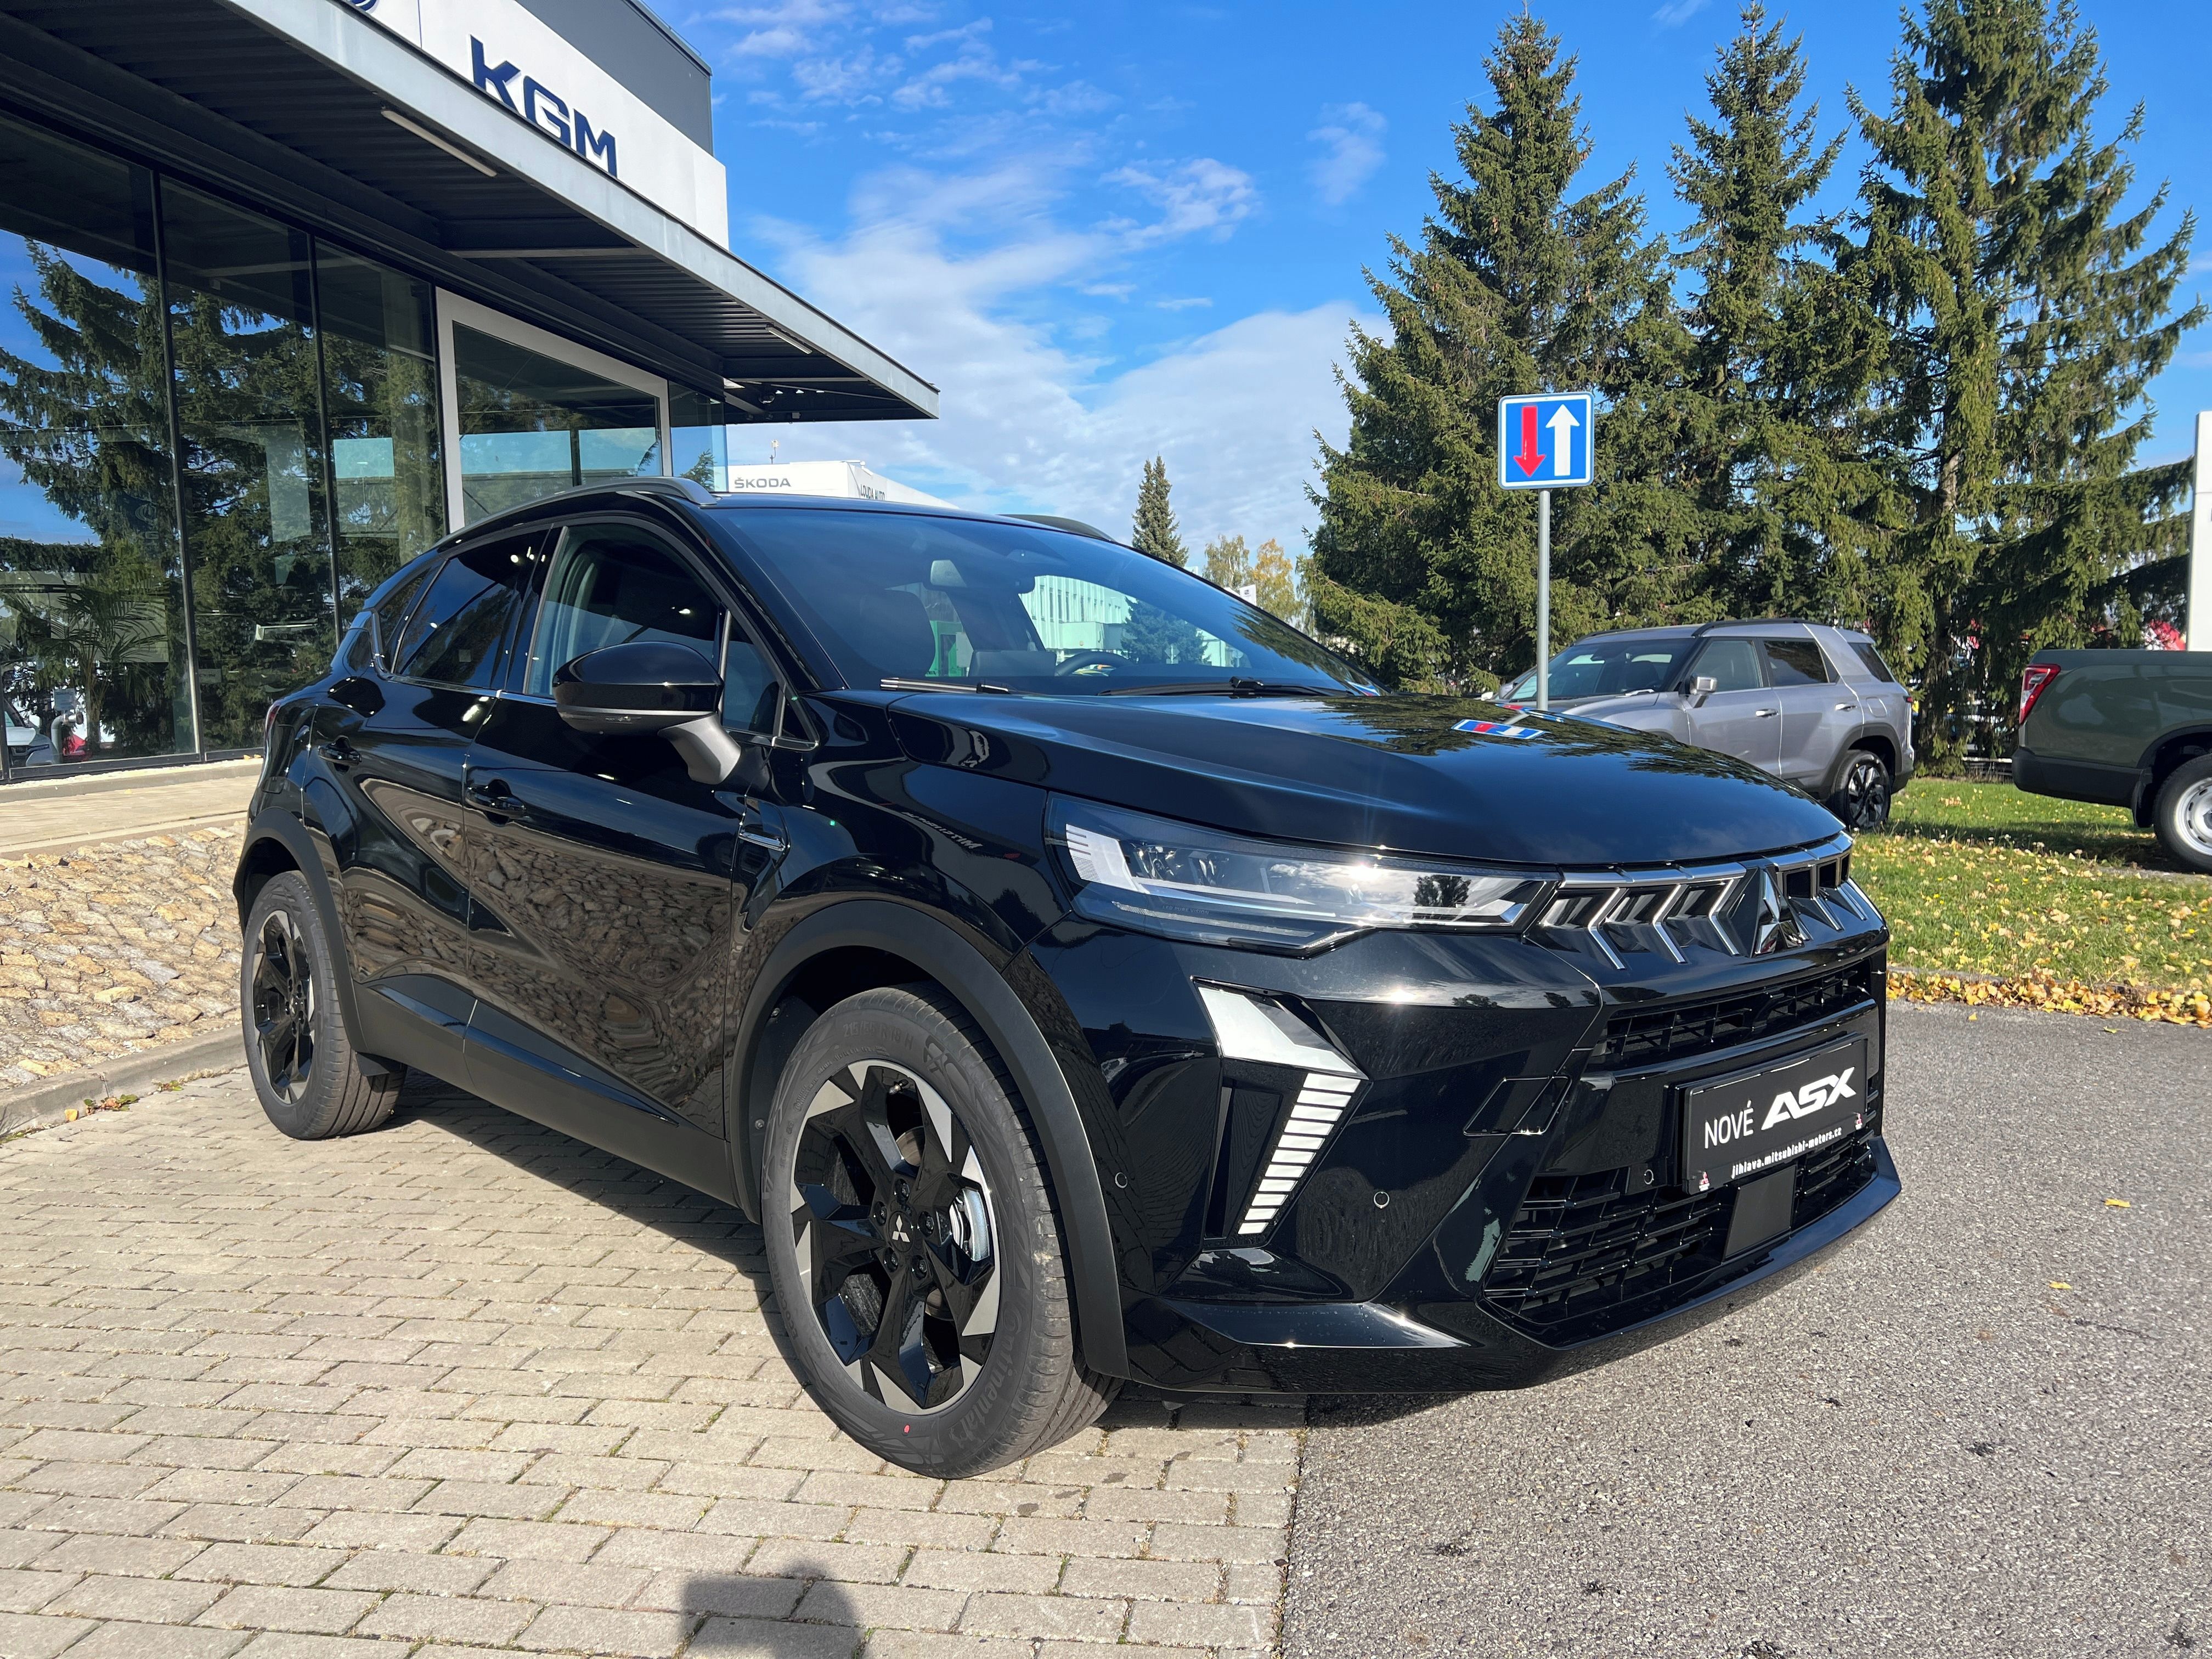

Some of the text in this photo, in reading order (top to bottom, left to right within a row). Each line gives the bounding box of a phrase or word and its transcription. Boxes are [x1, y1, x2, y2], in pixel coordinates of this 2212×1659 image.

[470, 34, 617, 177] KGM
[735, 477, 791, 488] ŠKODA
[1705, 1066, 1857, 1149] NOVÉ ASX
[1731, 1127, 1842, 1179] jihlava.mitsubishi-motors.cz
